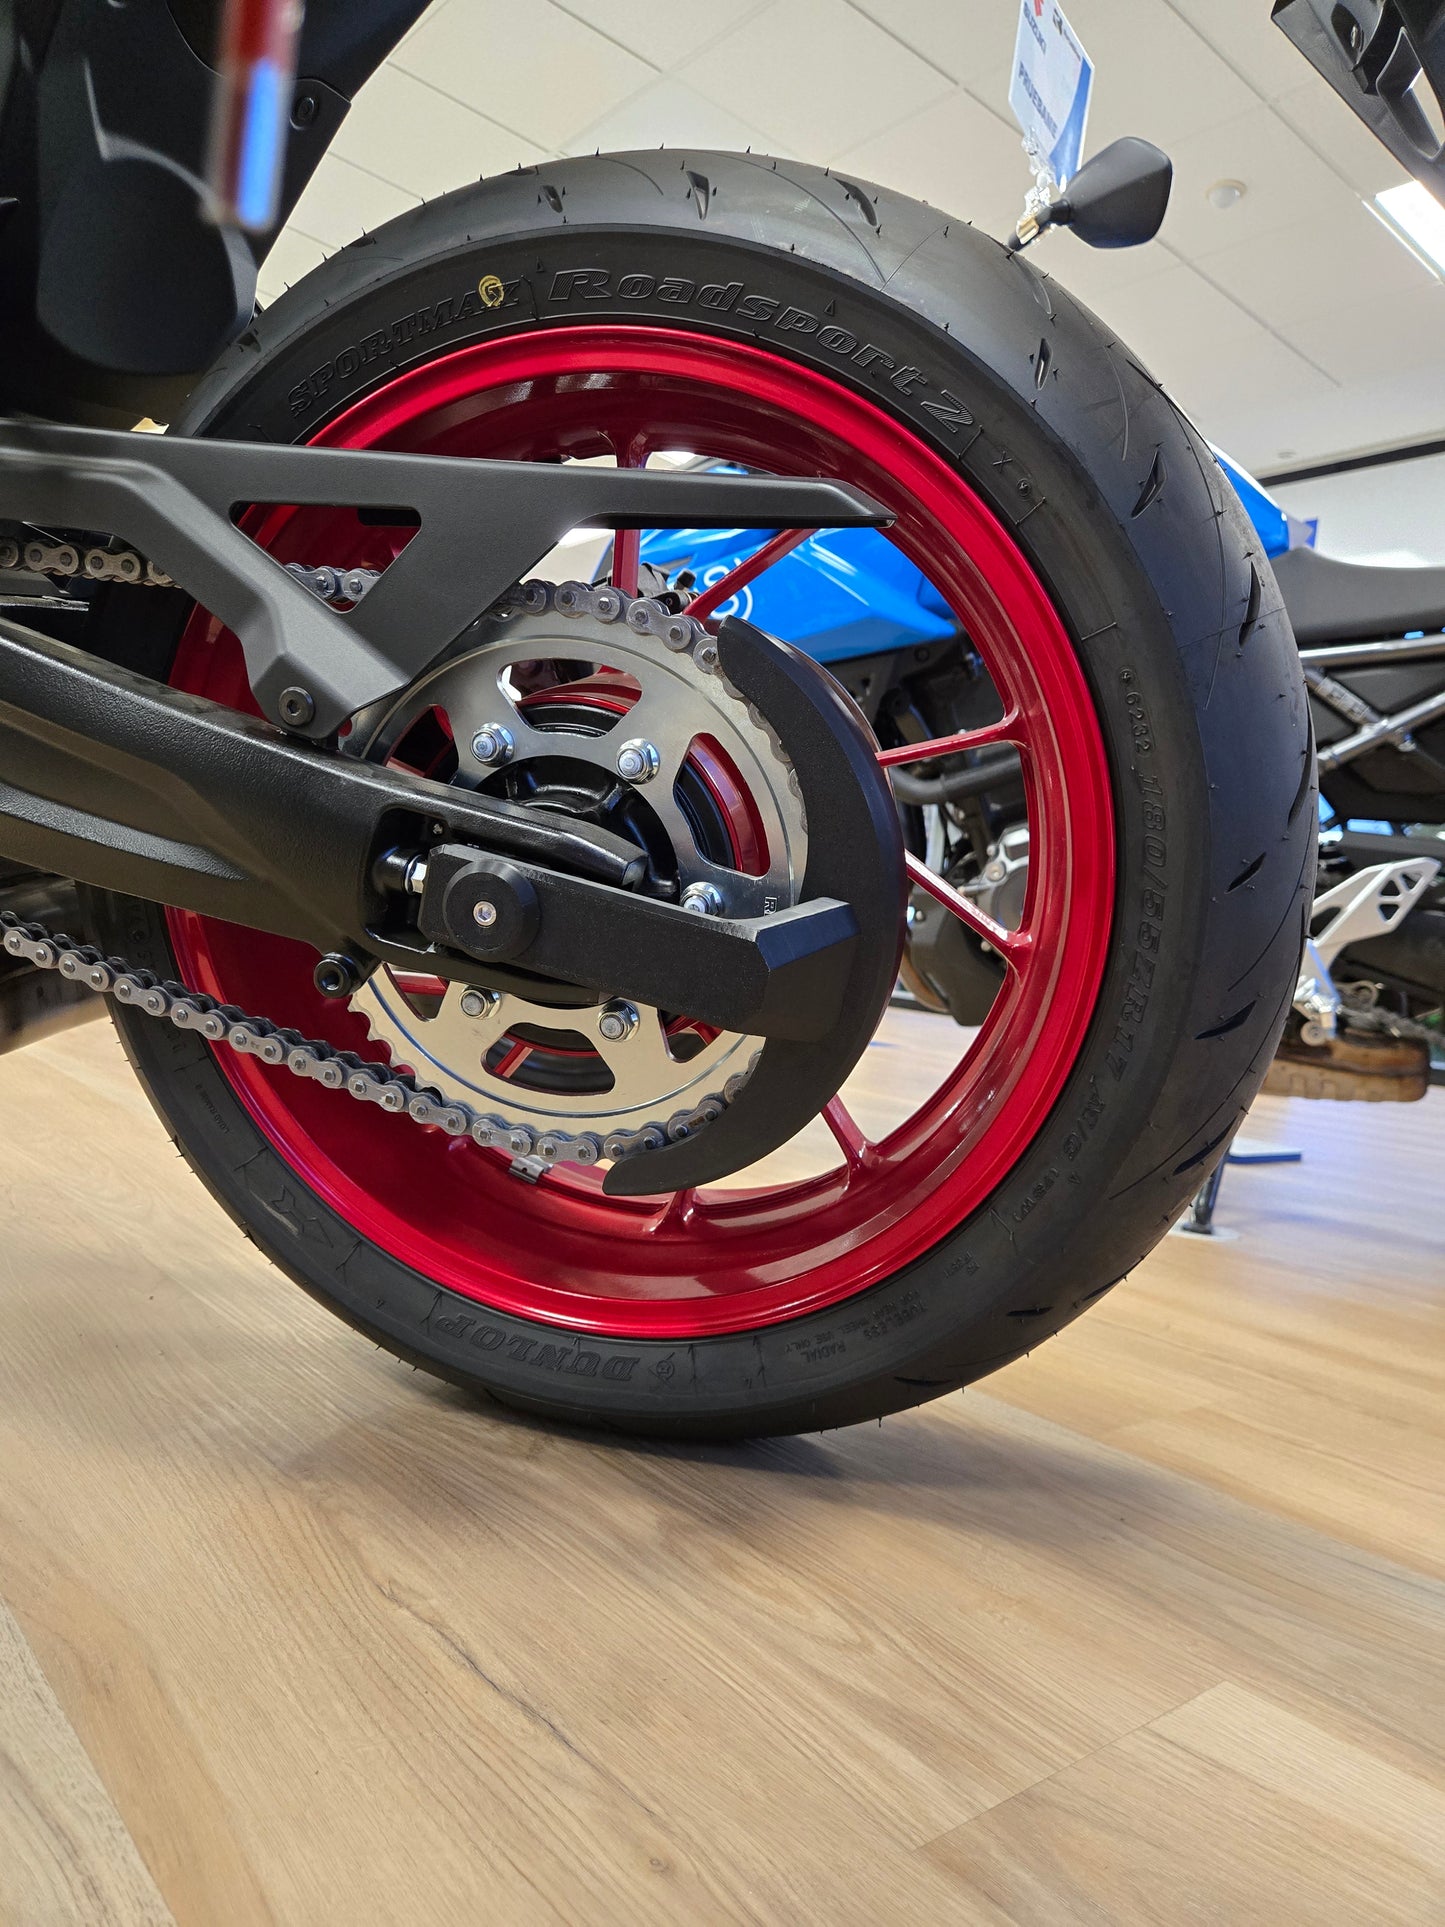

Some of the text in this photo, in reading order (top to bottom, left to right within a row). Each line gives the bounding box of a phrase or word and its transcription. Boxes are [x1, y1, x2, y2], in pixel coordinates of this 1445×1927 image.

[287, 279, 520, 419] SPORTMAX
[548, 268, 974, 434] Roadsport 2
[1102, 766, 1169, 1084] 180/55ZR17
[434, 1314, 641, 1382] DUNLOP
